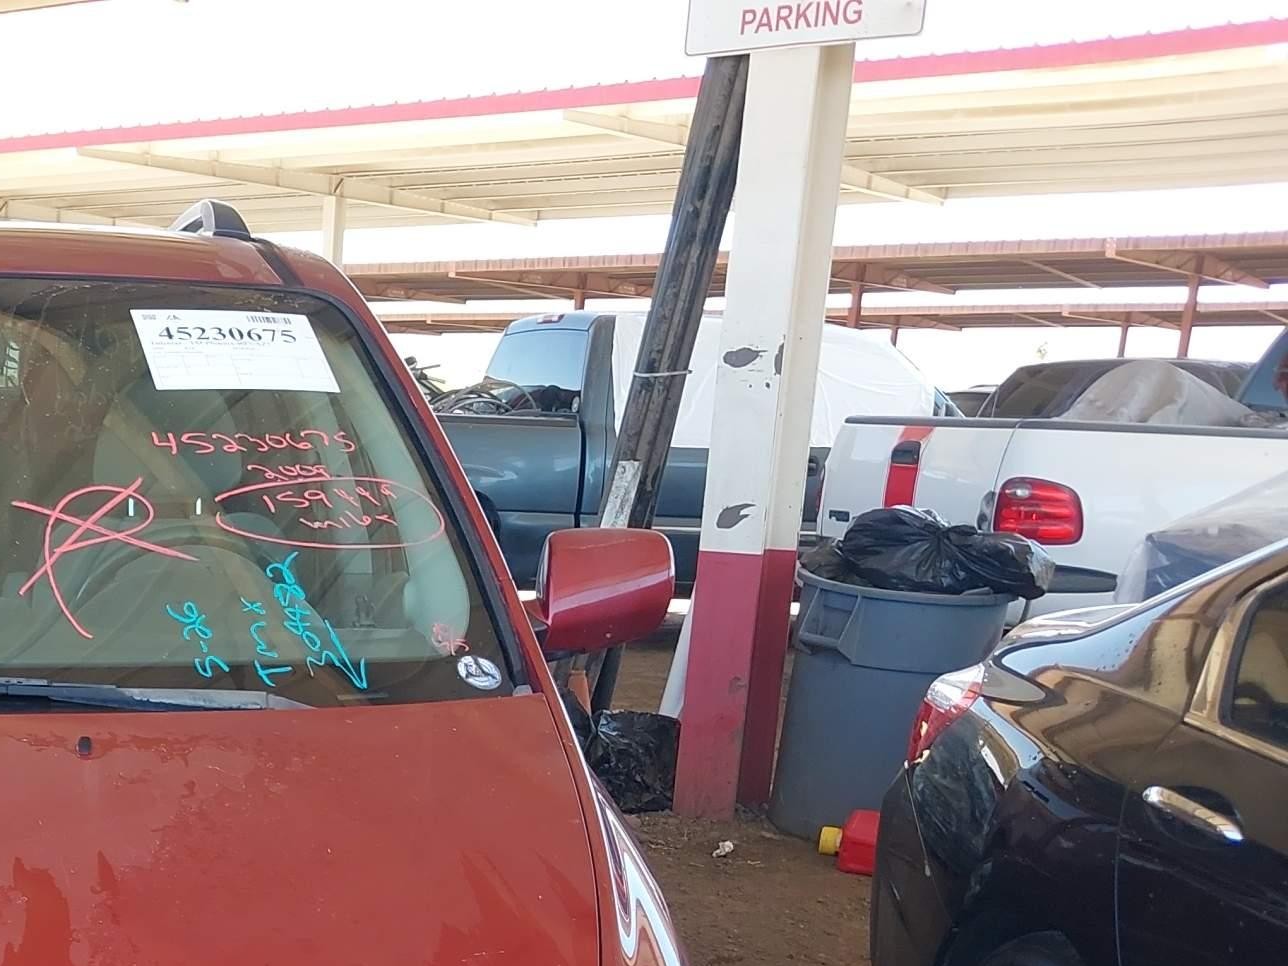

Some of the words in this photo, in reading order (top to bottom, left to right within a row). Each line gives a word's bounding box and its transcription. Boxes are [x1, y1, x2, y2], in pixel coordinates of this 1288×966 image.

[739, 0, 863, 35] PARKING
[158, 326, 297, 343] 45230675
[151, 430, 356, 455] 45230675
